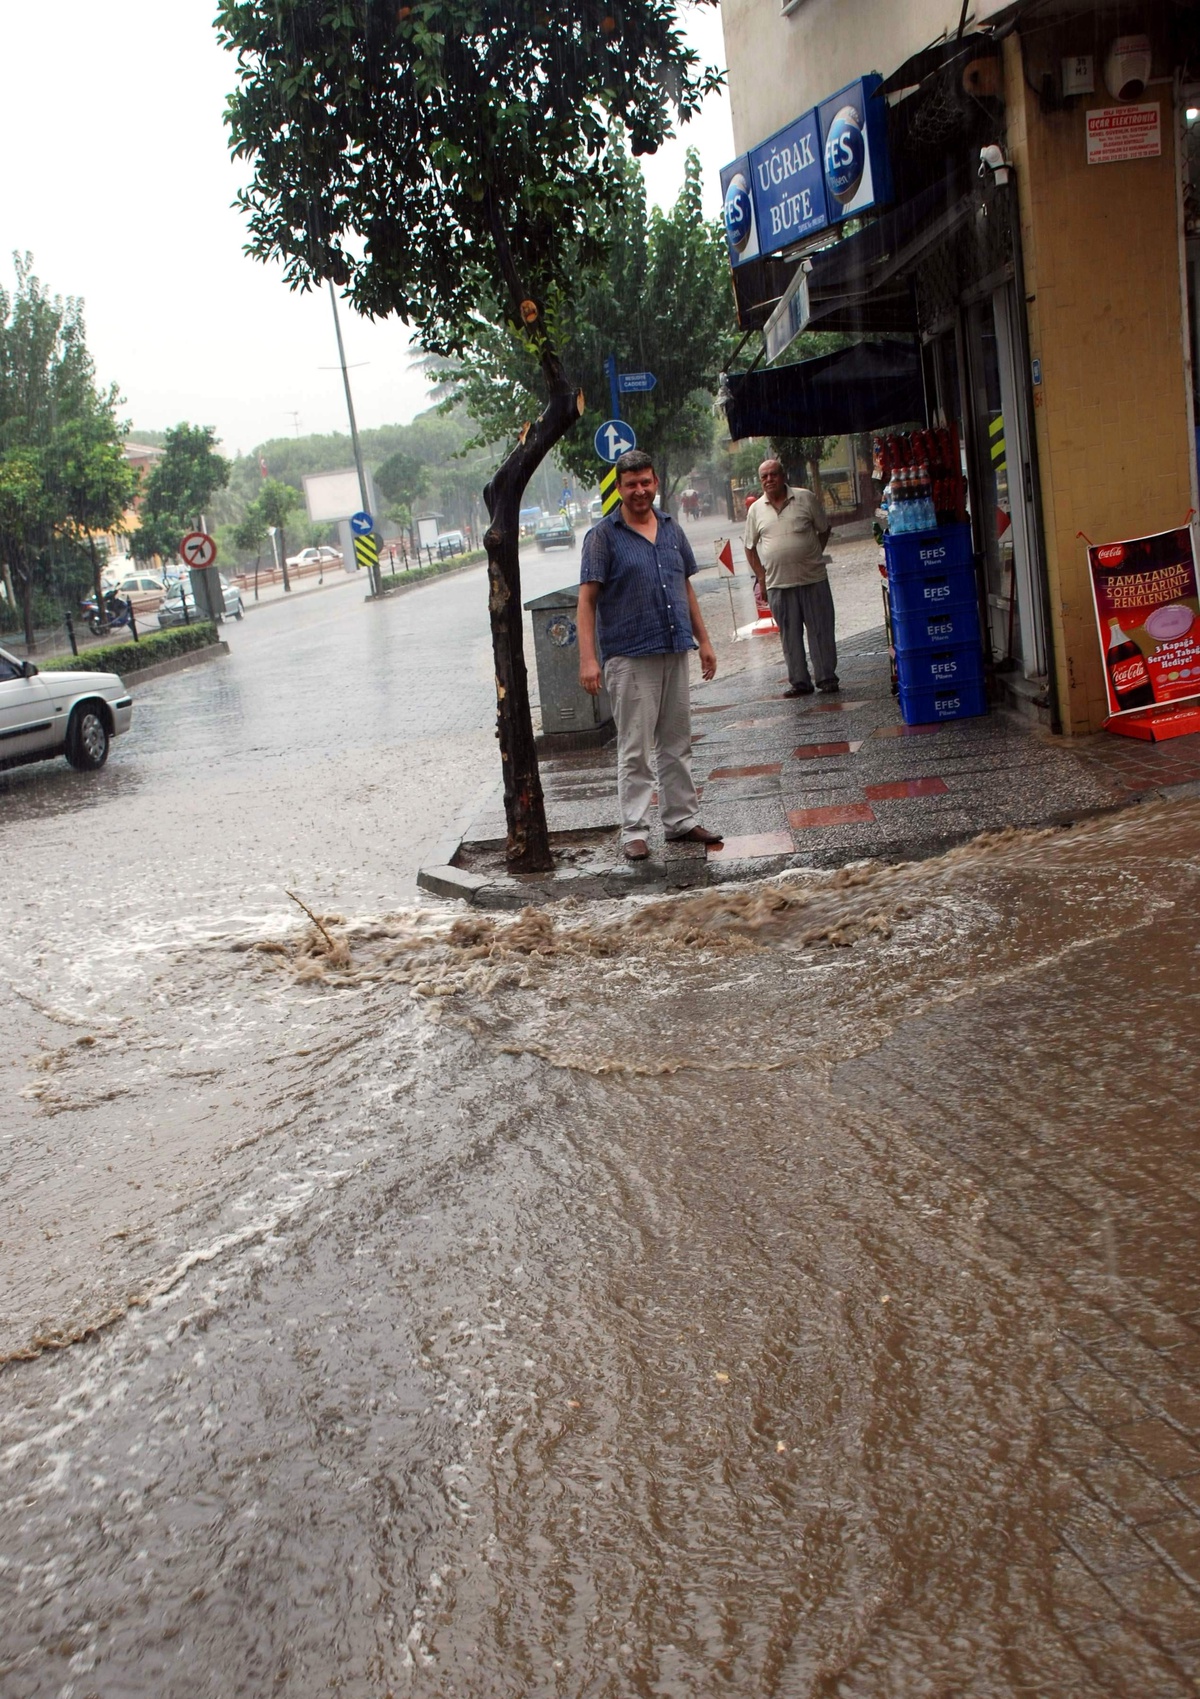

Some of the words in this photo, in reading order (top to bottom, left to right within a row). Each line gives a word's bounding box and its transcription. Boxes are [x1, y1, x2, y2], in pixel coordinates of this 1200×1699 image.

[1090, 117, 1110, 130] UÇAR
[757, 133, 816, 191] UĞRAK
[770, 188, 813, 236] BÜFE
[920, 547, 946, 560] EFES
[1107, 564, 1185, 587] RAMAZANDA
[1106, 572, 1191, 598] SOFRALARINIZ
[923, 586, 950, 599] EFES
[927, 623, 953, 636] EFES
[1147, 652, 1175, 664] Servis
[1175, 645, 1200, 658] Tabağ
[1155, 646, 1161, 654] 3
[930, 661, 957, 674] EFES
[1161, 655, 1193, 670] Hediye!
[934, 698, 960, 711] EFES
